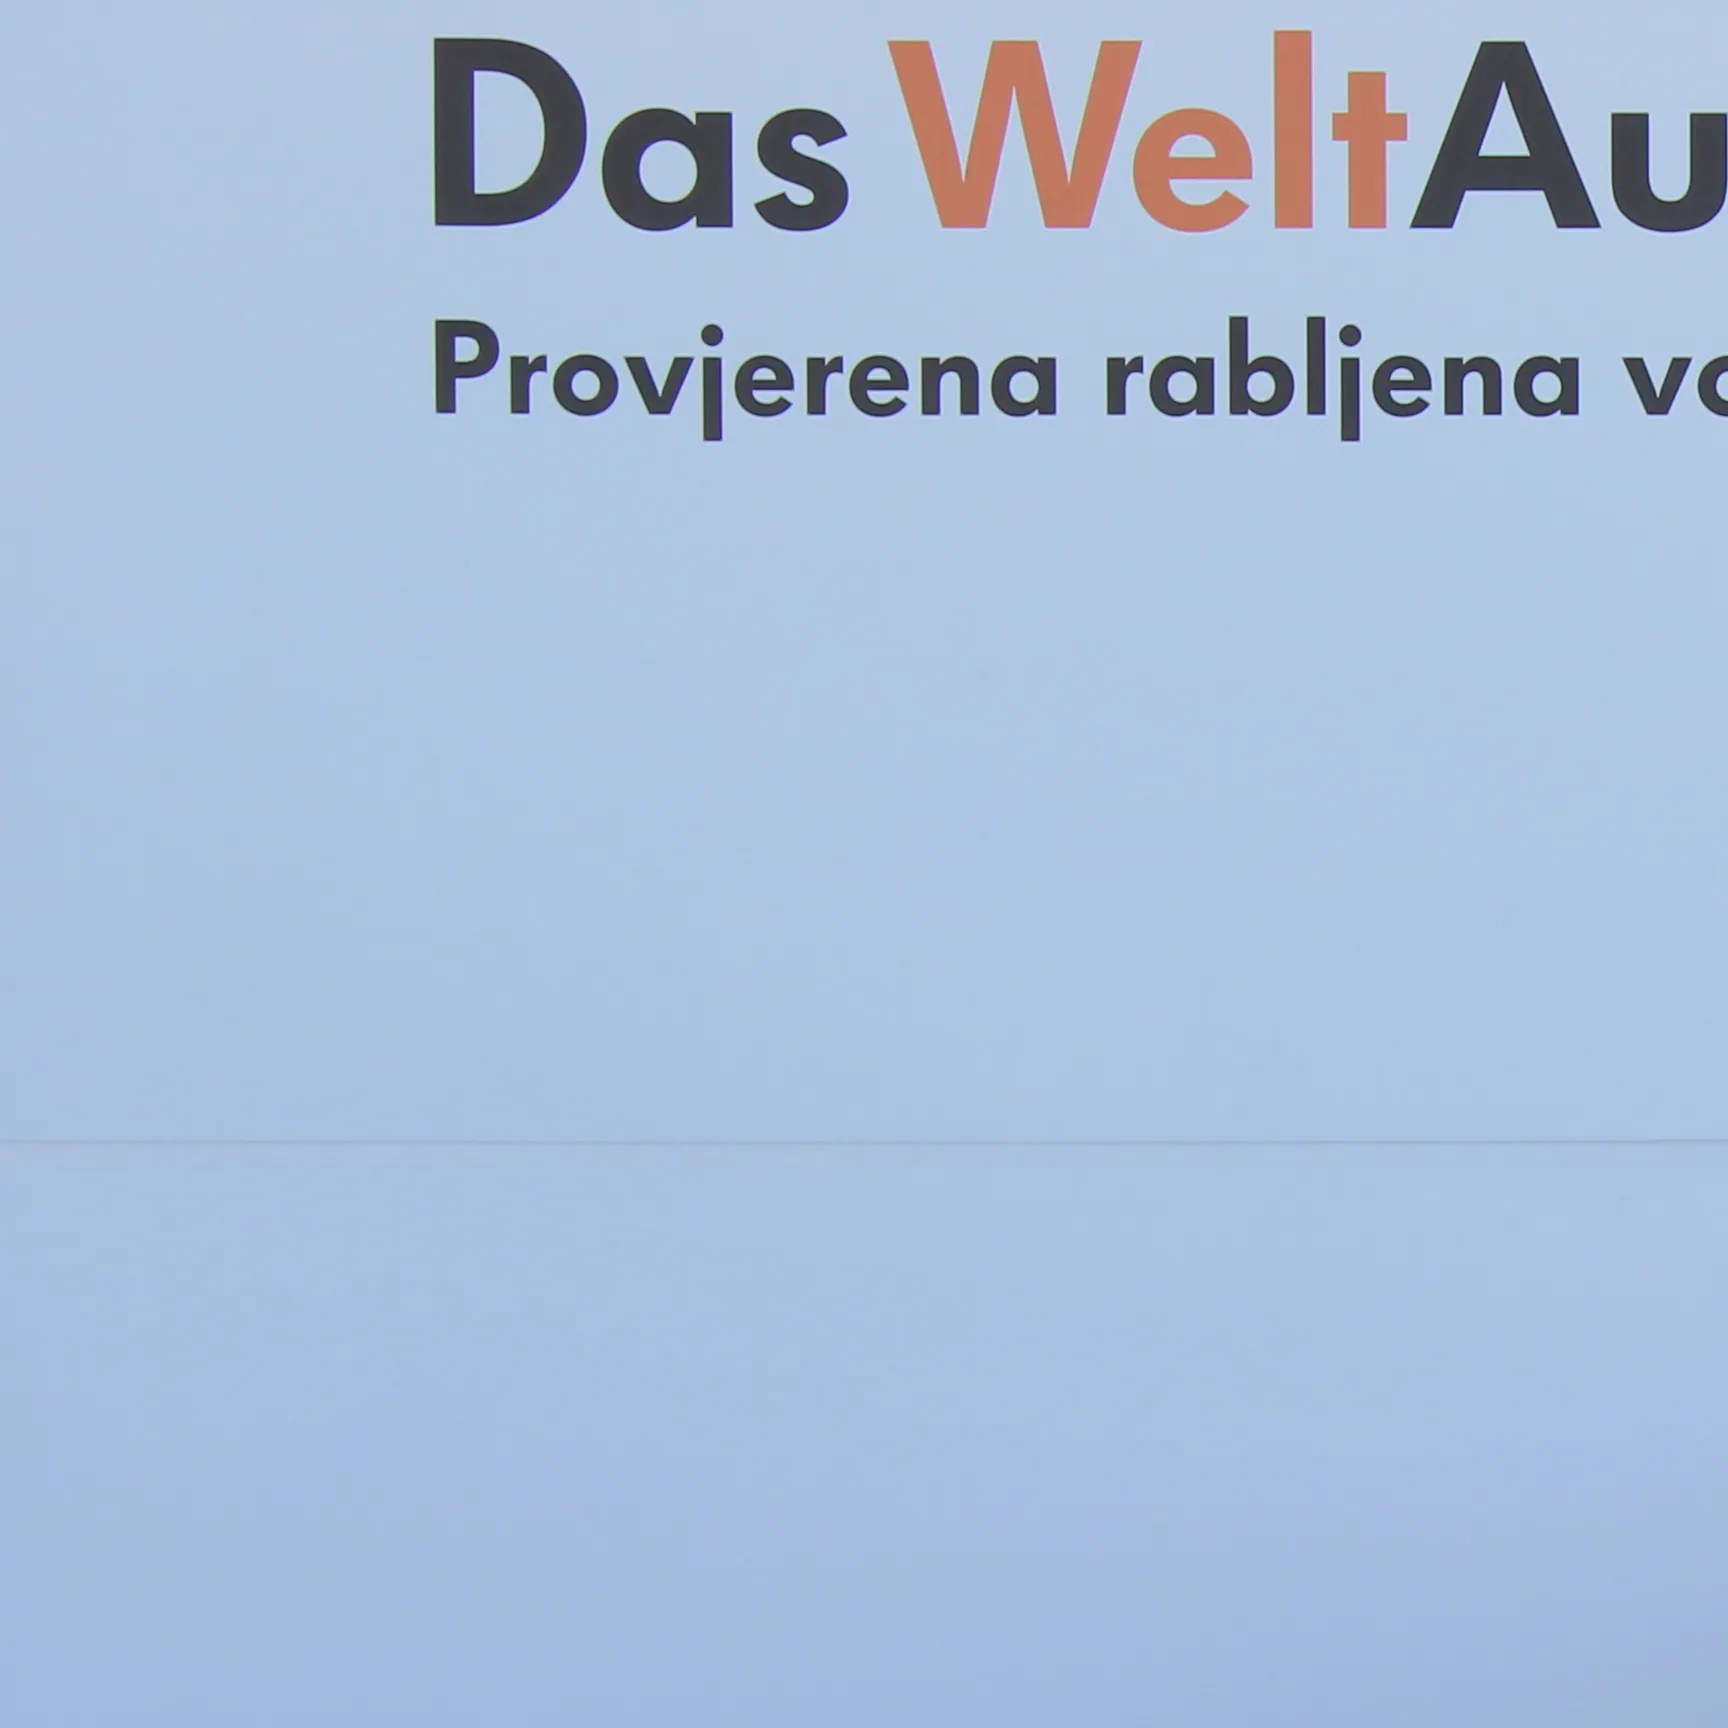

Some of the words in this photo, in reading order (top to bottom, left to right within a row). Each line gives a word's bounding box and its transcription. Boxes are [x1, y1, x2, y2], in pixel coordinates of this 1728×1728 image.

[432, 36, 850, 233] Das
[433, 318, 1058, 443] Provjerena
[1105, 314, 1580, 443] rabljena
